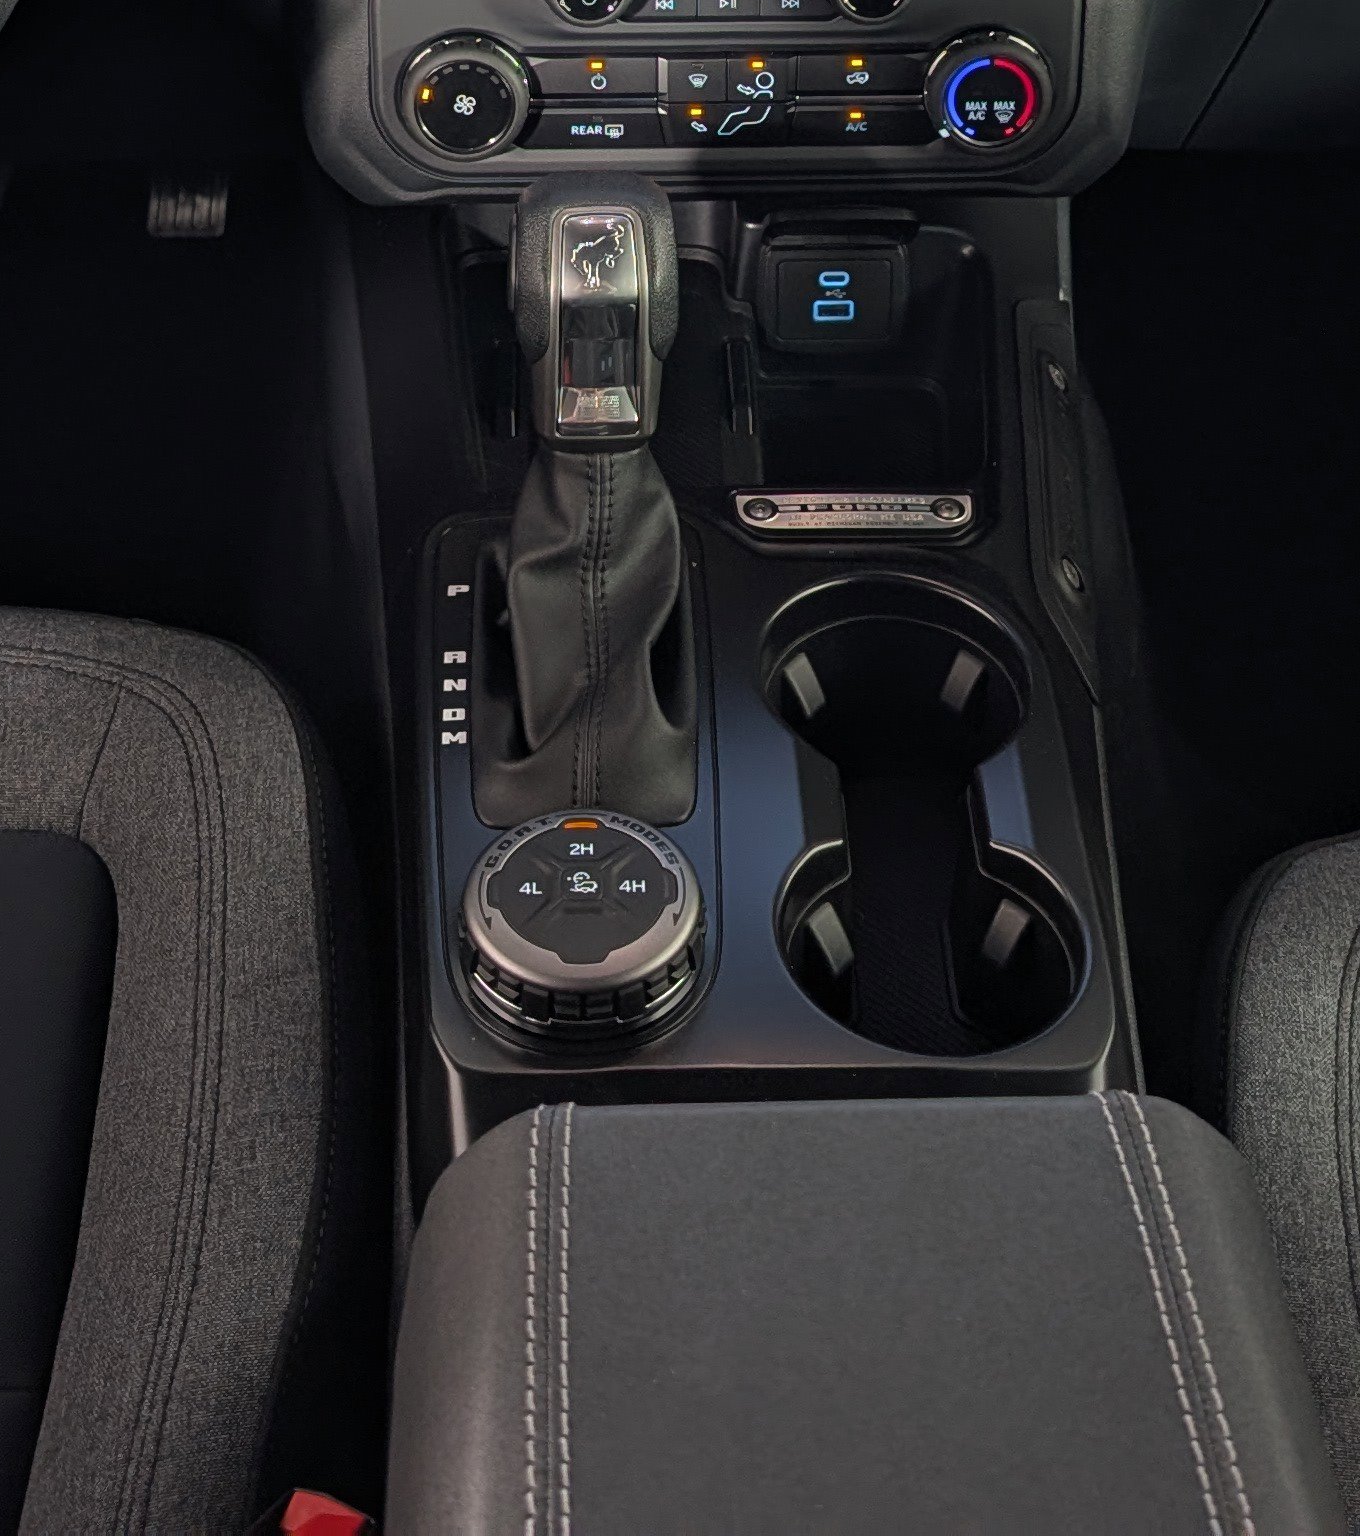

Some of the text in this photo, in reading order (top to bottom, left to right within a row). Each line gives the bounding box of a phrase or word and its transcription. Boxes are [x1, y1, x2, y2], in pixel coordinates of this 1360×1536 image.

[964, 99, 1016, 111] MAX MAX
[967, 110, 986, 121] A/C
[571, 125, 603, 136] REAR
[845, 122, 868, 132] A/C
[446, 584, 470, 597] P
[443, 678, 467, 692] N
[441, 730, 468, 745] M
[609, 815, 680, 865] MODES
[569, 842, 594, 857] 2H
[518, 881, 543, 896] 4L
[618, 879, 646, 894] 4H
